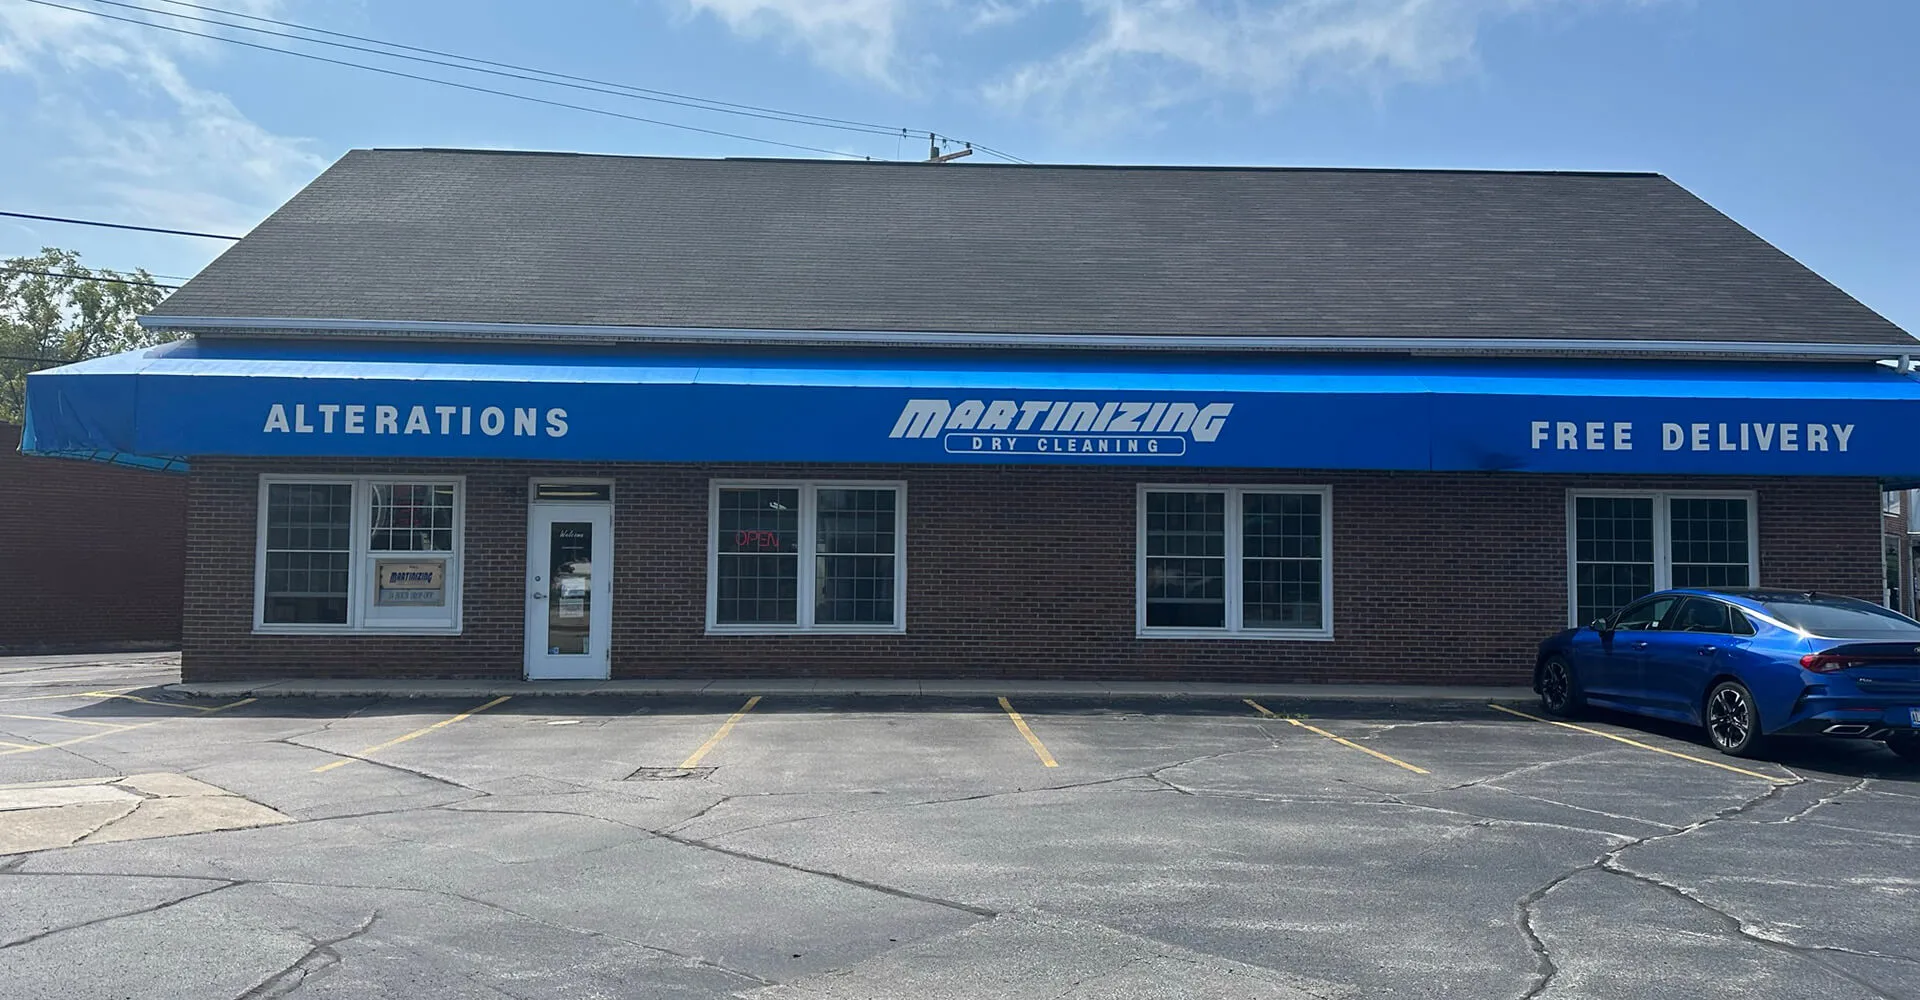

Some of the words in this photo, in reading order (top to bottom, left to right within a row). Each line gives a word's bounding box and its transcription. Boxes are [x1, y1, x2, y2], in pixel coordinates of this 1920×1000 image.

[264, 404, 569, 437] ALTERATIONS
[888, 399, 1234, 442] MARTINIZING
[972, 437, 1017, 451] DRY
[1037, 438, 1159, 453] CLEANING
[1531, 421, 1633, 450] FREE
[1662, 423, 1855, 452] DELIVERY
[735, 530, 780, 546] OPEN
